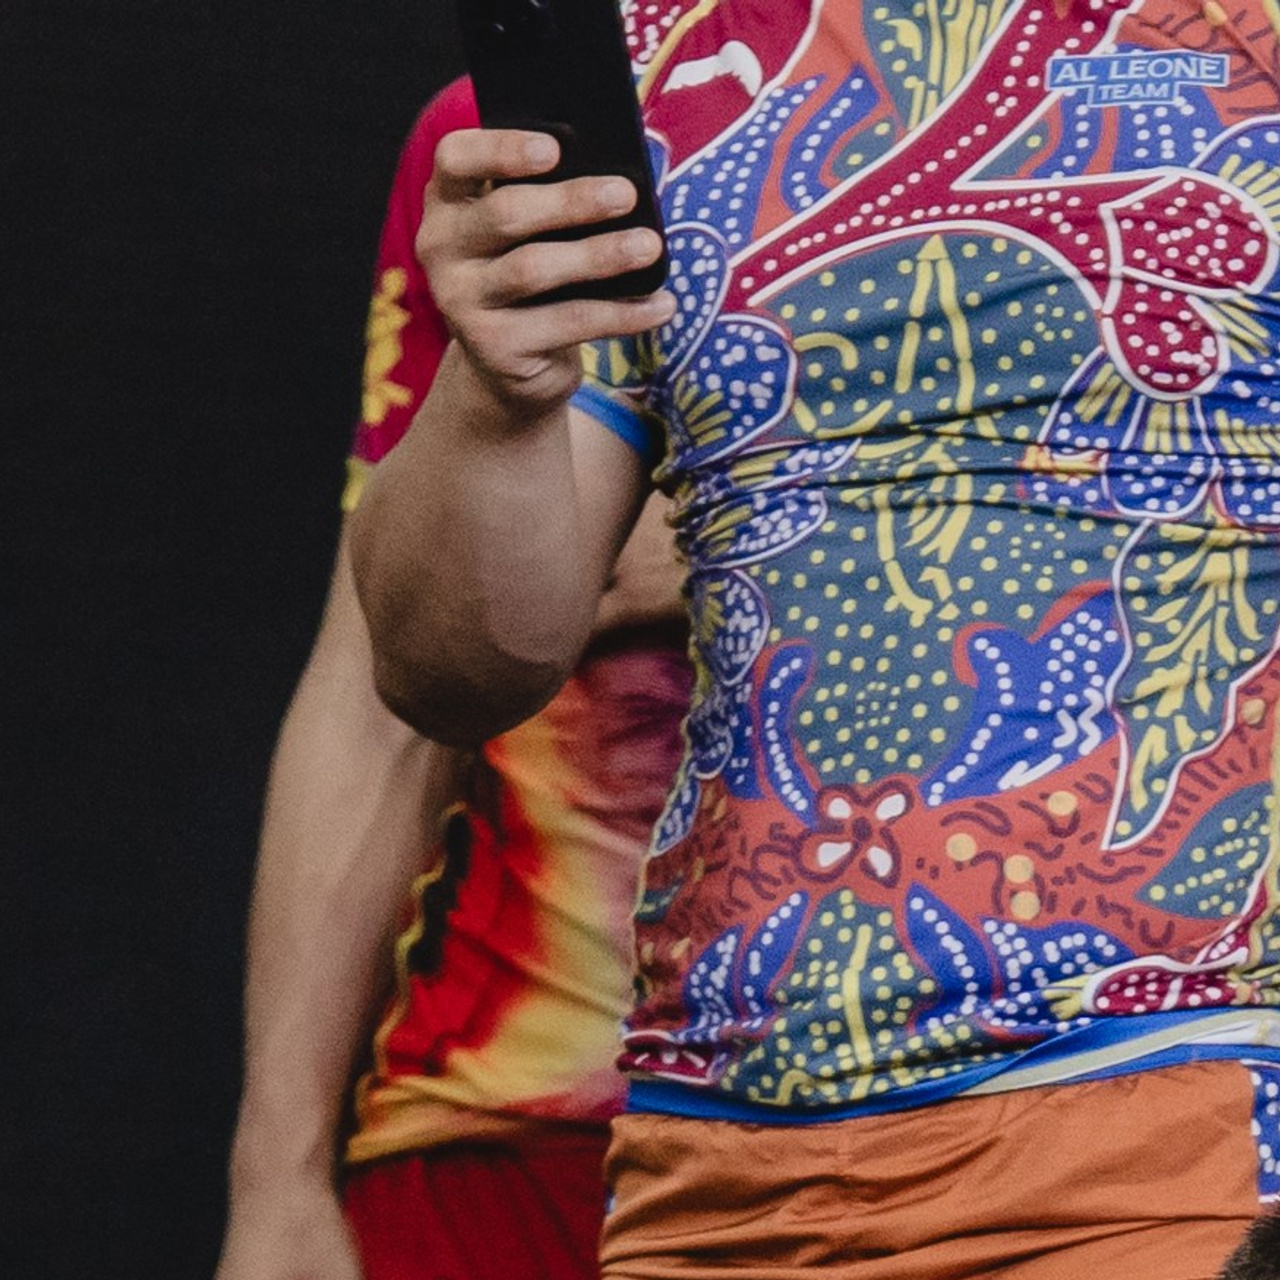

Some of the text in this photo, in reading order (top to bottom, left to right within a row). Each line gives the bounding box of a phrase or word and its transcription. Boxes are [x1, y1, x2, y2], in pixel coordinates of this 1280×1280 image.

[1054, 57, 1222, 83] AL LEONE
[1099, 83, 1169, 100] TEAM
